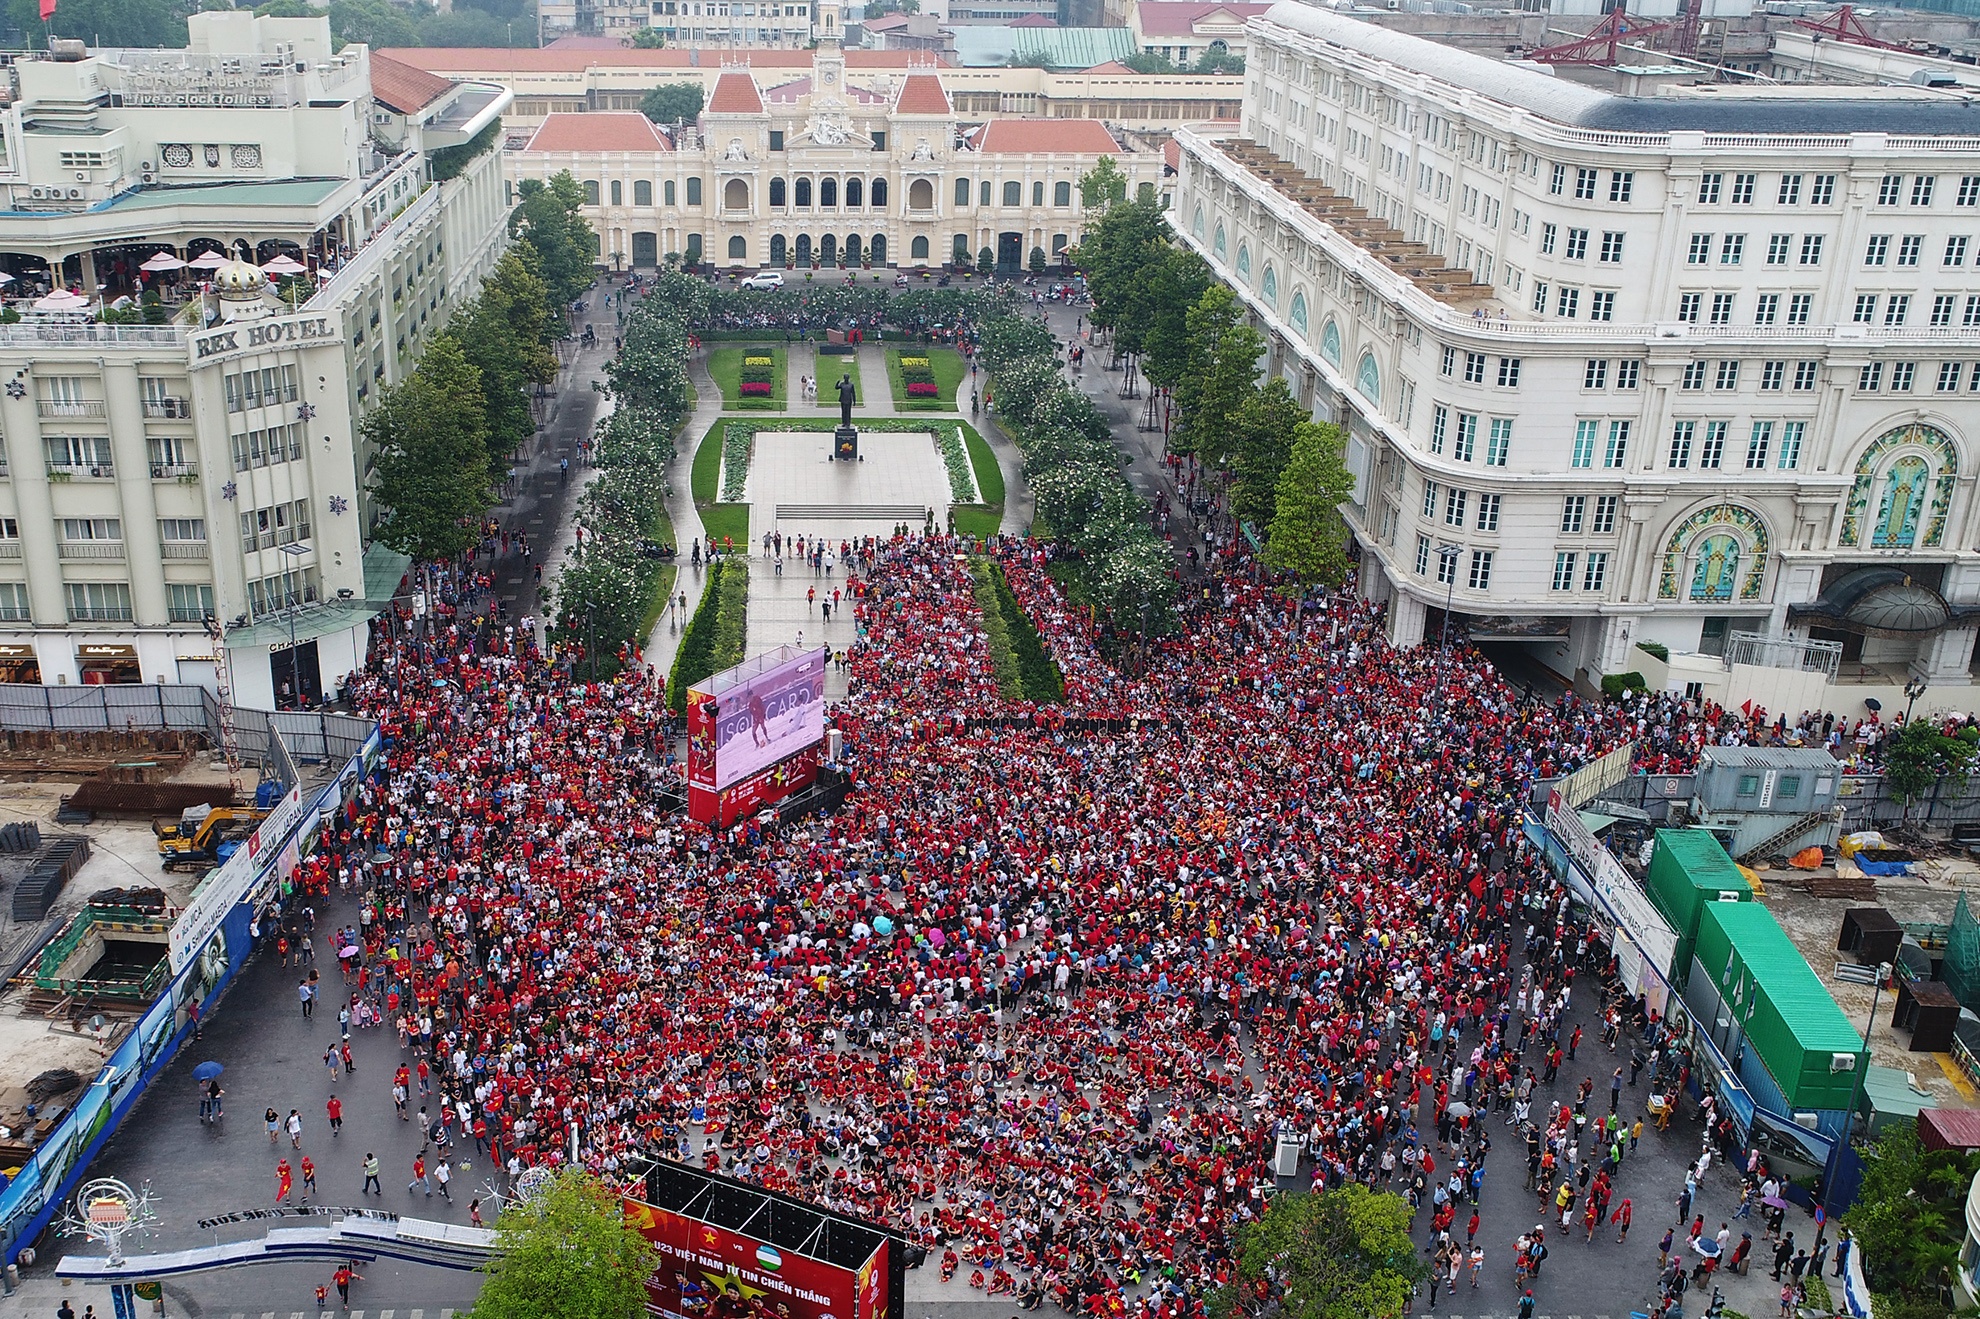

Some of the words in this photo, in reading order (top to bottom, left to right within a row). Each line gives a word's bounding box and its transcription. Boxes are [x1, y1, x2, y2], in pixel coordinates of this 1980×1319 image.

[127, 76, 187, 88] ROOFTOP
[191, 77, 244, 88] GARDEN
[247, 78, 272, 88] BAR
[195, 330, 240, 359] REX
[248, 318, 335, 347] HOTEL
[269, 637, 318, 652] CHAN
[765, 688, 810, 721] CARD
[251, 832, 277, 871] VIETNAM
[282, 803, 302, 834] JAPAN
[1578, 846, 1598, 877] JAPAN
[1615, 872, 1626, 893] JICA
[189, 905, 203, 928] JICA
[191, 899, 227, 949] SHIMIZU-MAEDA
[654, 1240, 673, 1254] U23
[674, 1248, 697, 1262] VIỆT
[699, 1255, 724, 1271] NAM
[725, 1264, 740, 1277] TỰ
[741, 1269, 759, 1283] TIN
[760, 1275, 793, 1295] CHIẾN
[794, 1287, 831, 1307] THẮNG
